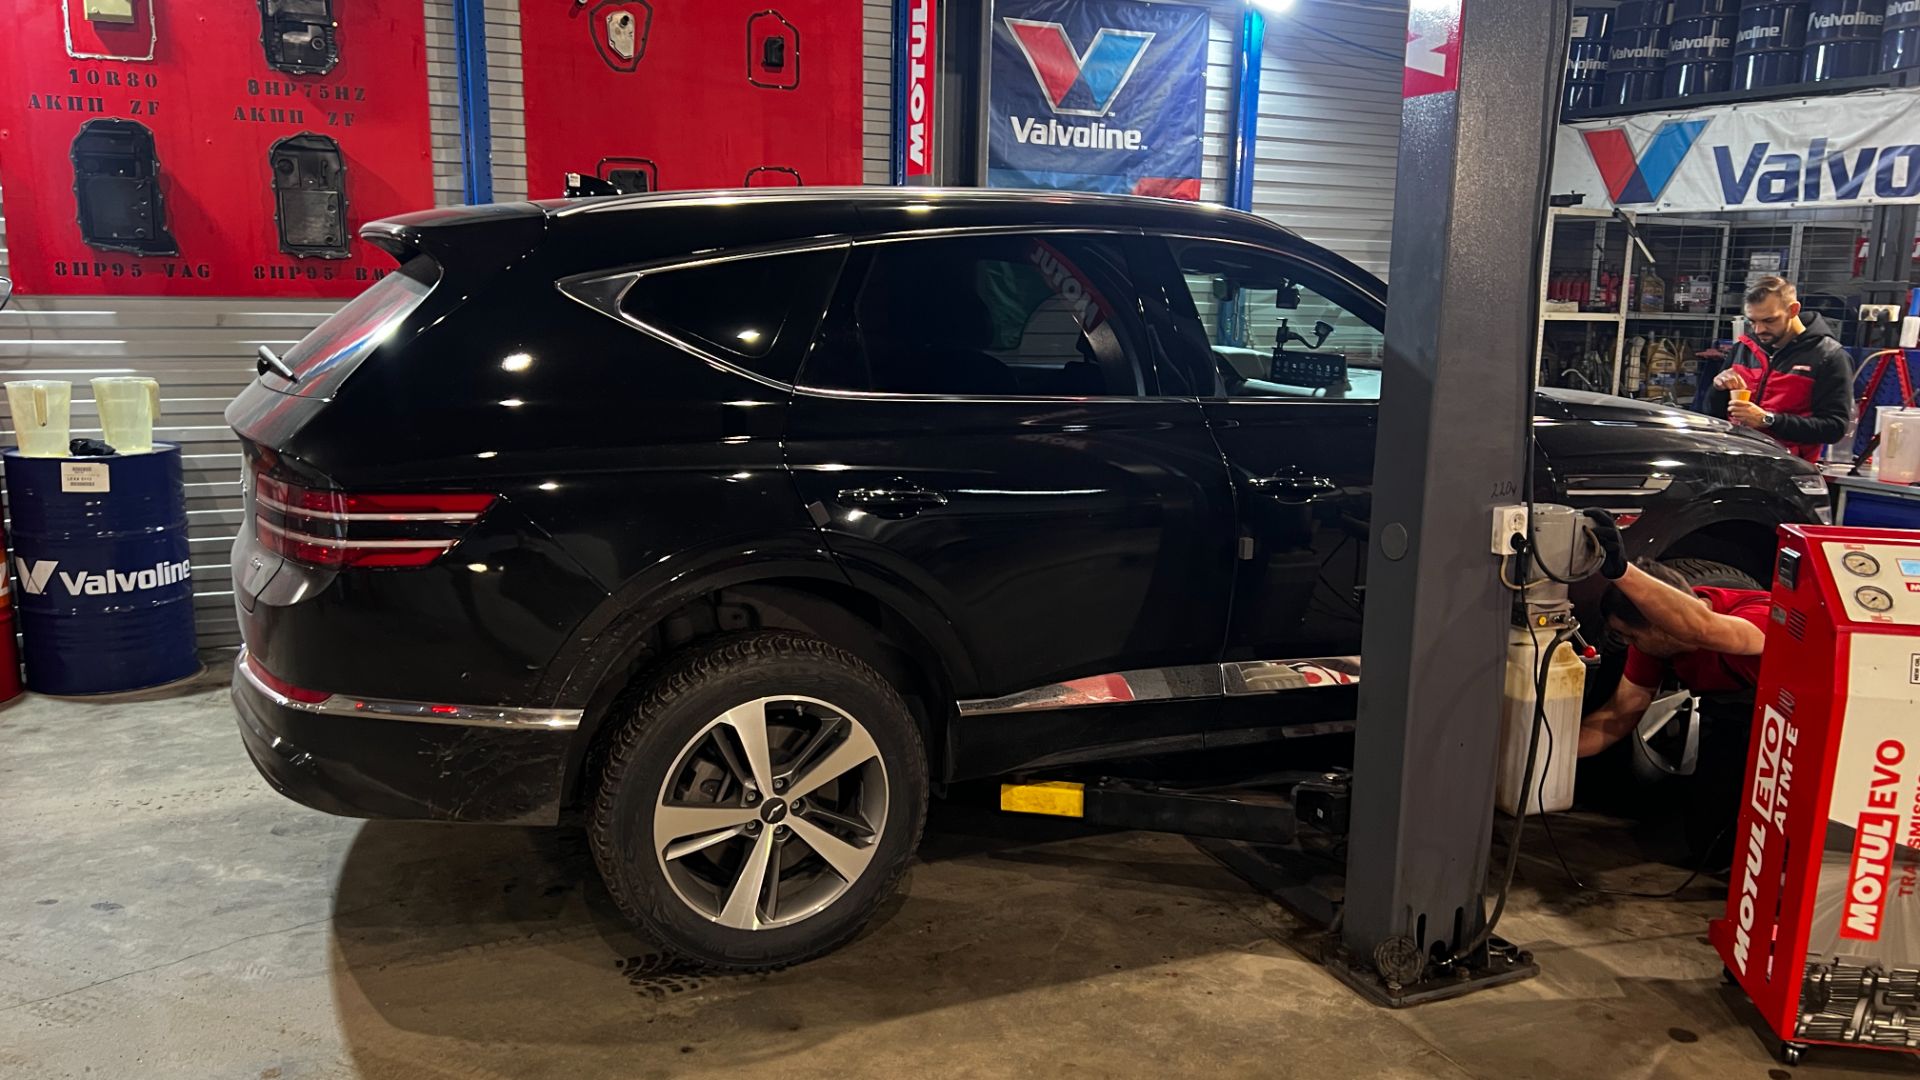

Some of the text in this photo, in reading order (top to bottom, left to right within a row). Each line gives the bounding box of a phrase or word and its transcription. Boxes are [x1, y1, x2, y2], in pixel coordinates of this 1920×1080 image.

[1814, 11, 1884, 29] Valvoline
[1612, 45, 1669, 61] Valvoline
[1671, 35, 1730, 51] Valvoline
[69, 68, 158, 88] 10R80
[909, 0, 928, 166] MOTUL
[247, 79, 366, 101] 8HP75HZ
[130, 100, 160, 116] ZF
[327, 111, 355, 127] ZF
[1010, 116, 1142, 151] Valvoline
[55, 261, 210, 279] 8HP95 VAG
[253, 265, 334, 281] 8HP95
[59, 558, 192, 597] Valvoline
[1773, 722, 1799, 836] ATM-E
[1733, 716, 1780, 977] MOTUL EVO
[1846, 739, 1906, 936] MOTUL EVO
